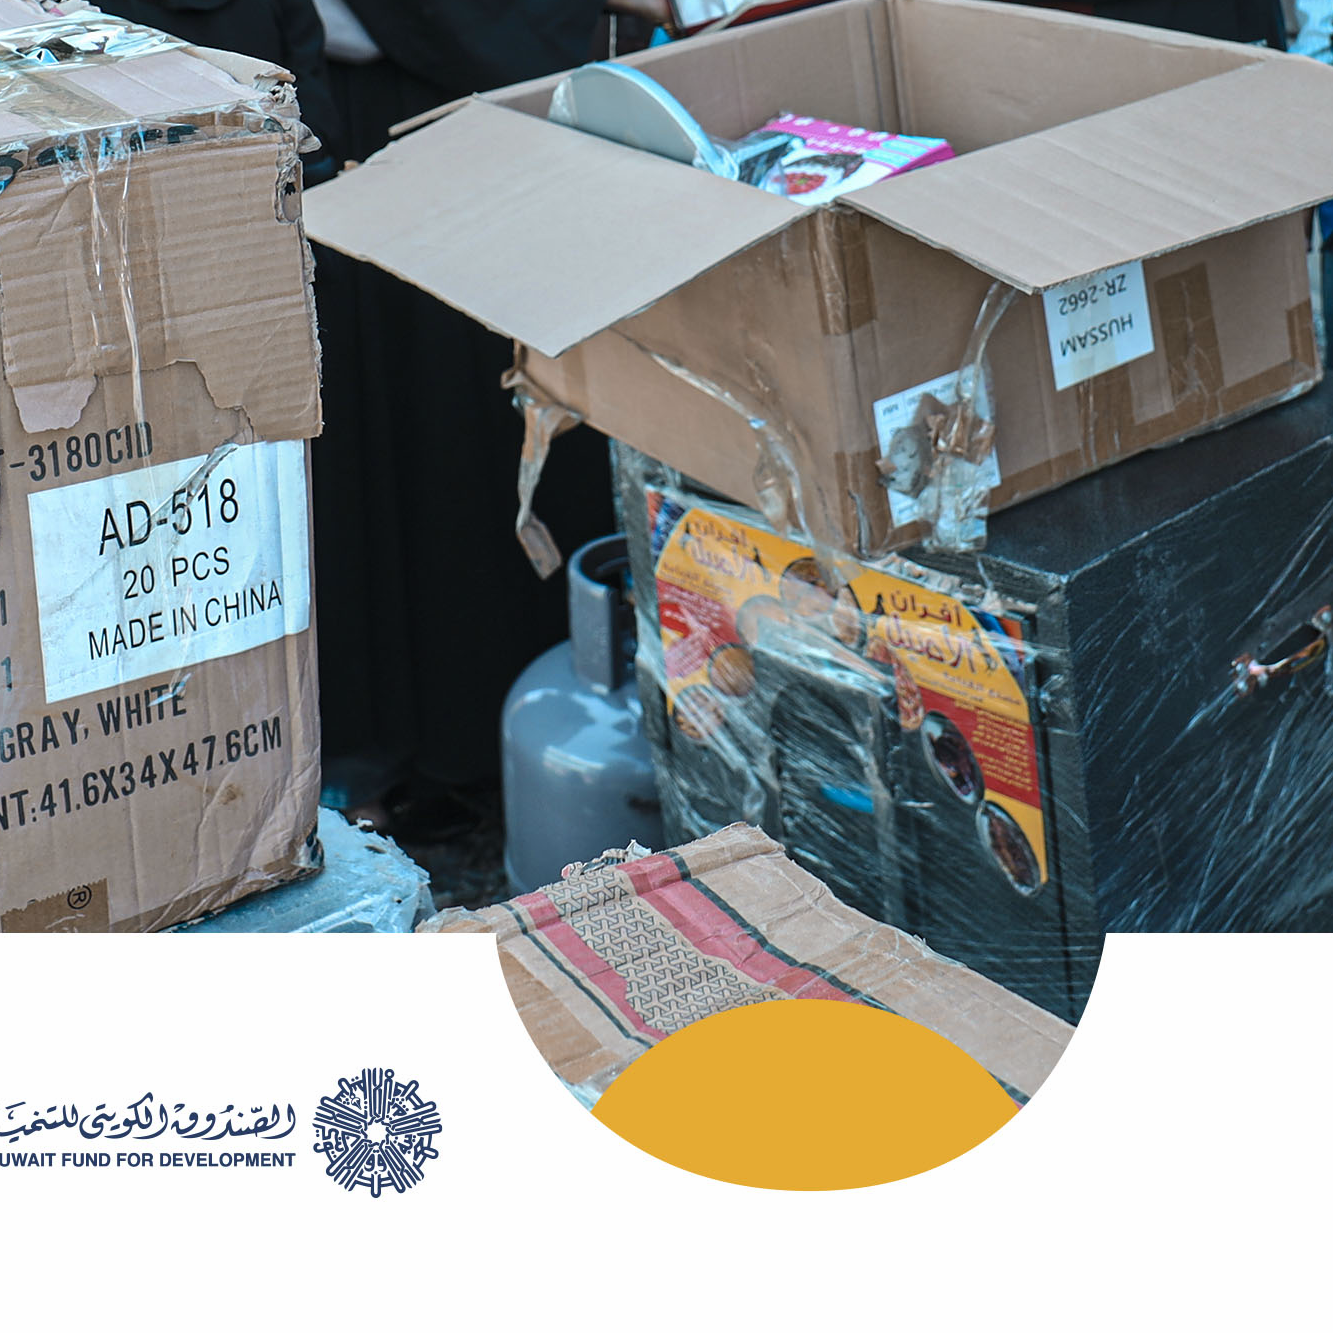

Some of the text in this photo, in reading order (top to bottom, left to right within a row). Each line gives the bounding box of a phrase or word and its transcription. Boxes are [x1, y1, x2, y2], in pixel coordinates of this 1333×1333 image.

[1058, 273, 1127, 316] ZR-2662
[1060, 313, 1134, 356] HUSSAM
[99, 478, 240, 556] AD-518
[123, 546, 230, 600] 20 PCS
[88, 580, 283, 660] MADE IN CHINA
[97, 680, 189, 736] WHITE
